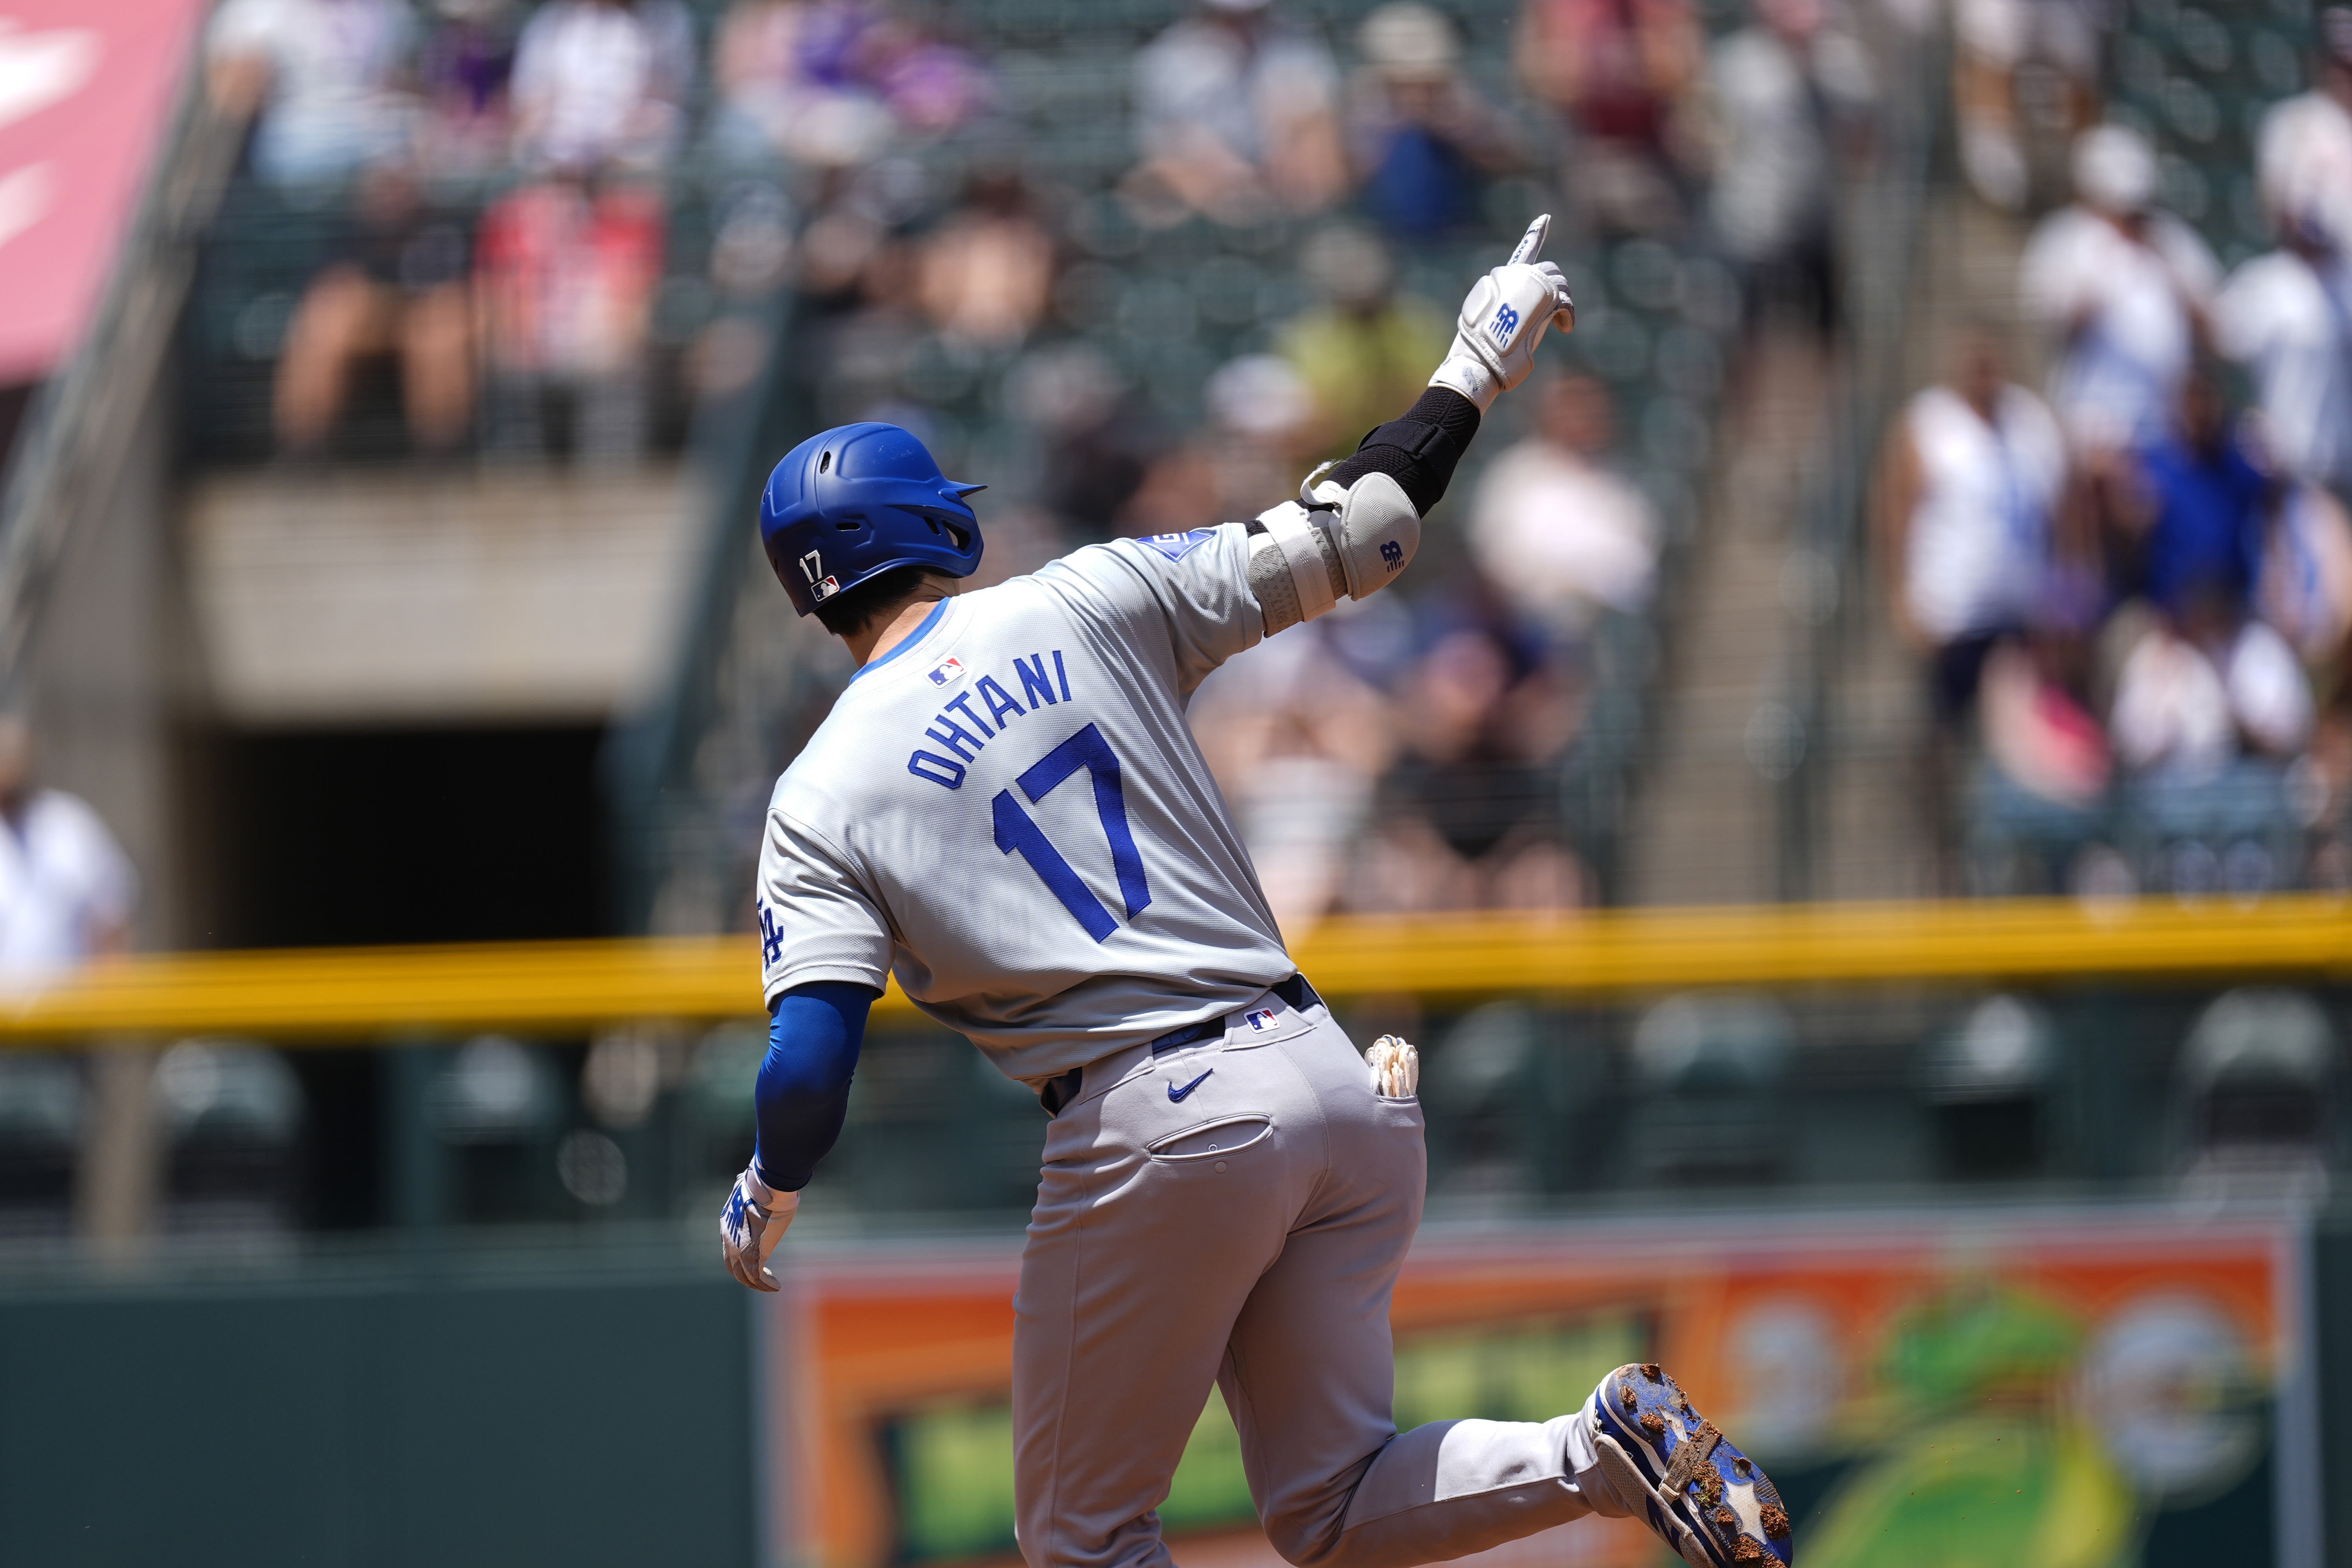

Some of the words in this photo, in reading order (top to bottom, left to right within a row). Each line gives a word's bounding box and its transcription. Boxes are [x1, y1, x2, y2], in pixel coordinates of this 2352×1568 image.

[799, 550, 823, 583] 17
[907, 650, 1071, 789] OHTANI
[992, 728, 1152, 944] 17
